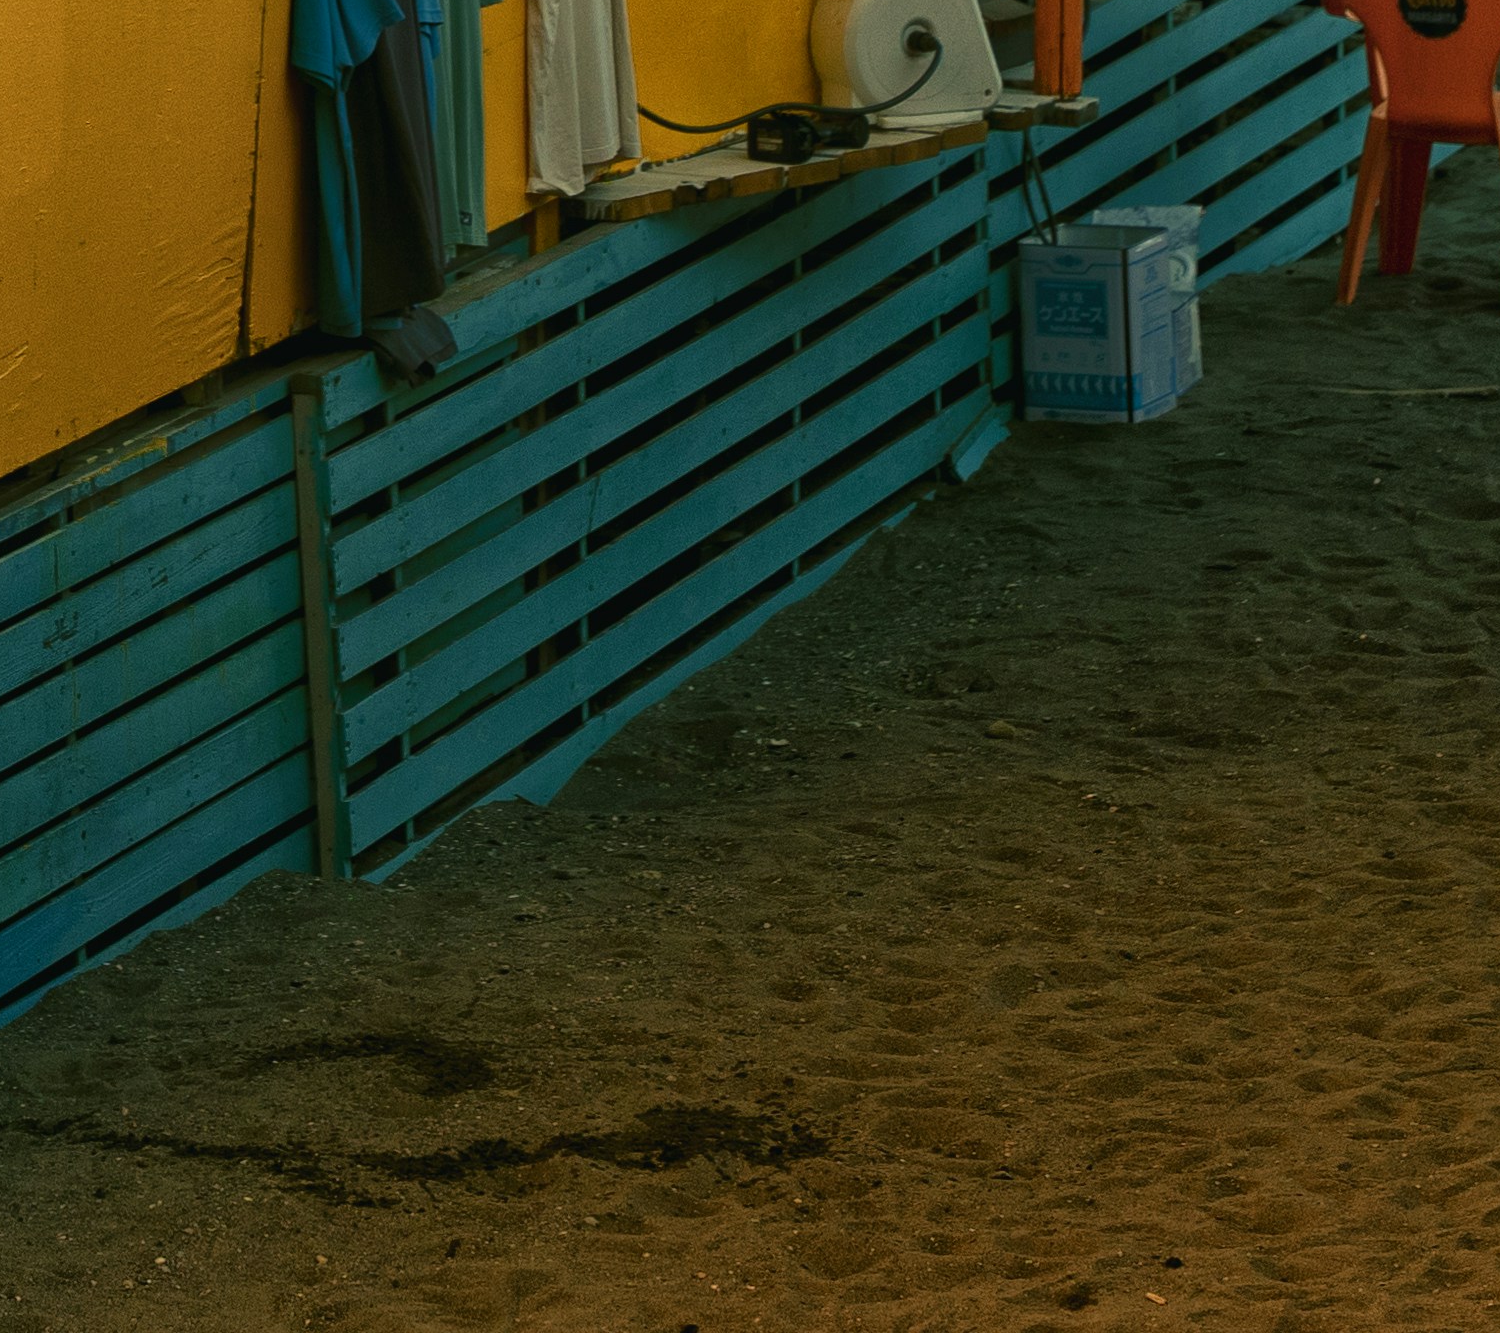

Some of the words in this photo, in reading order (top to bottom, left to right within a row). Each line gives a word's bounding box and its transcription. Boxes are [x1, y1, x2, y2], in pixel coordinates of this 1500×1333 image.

[1038, 305, 1105, 324] ケンエース
